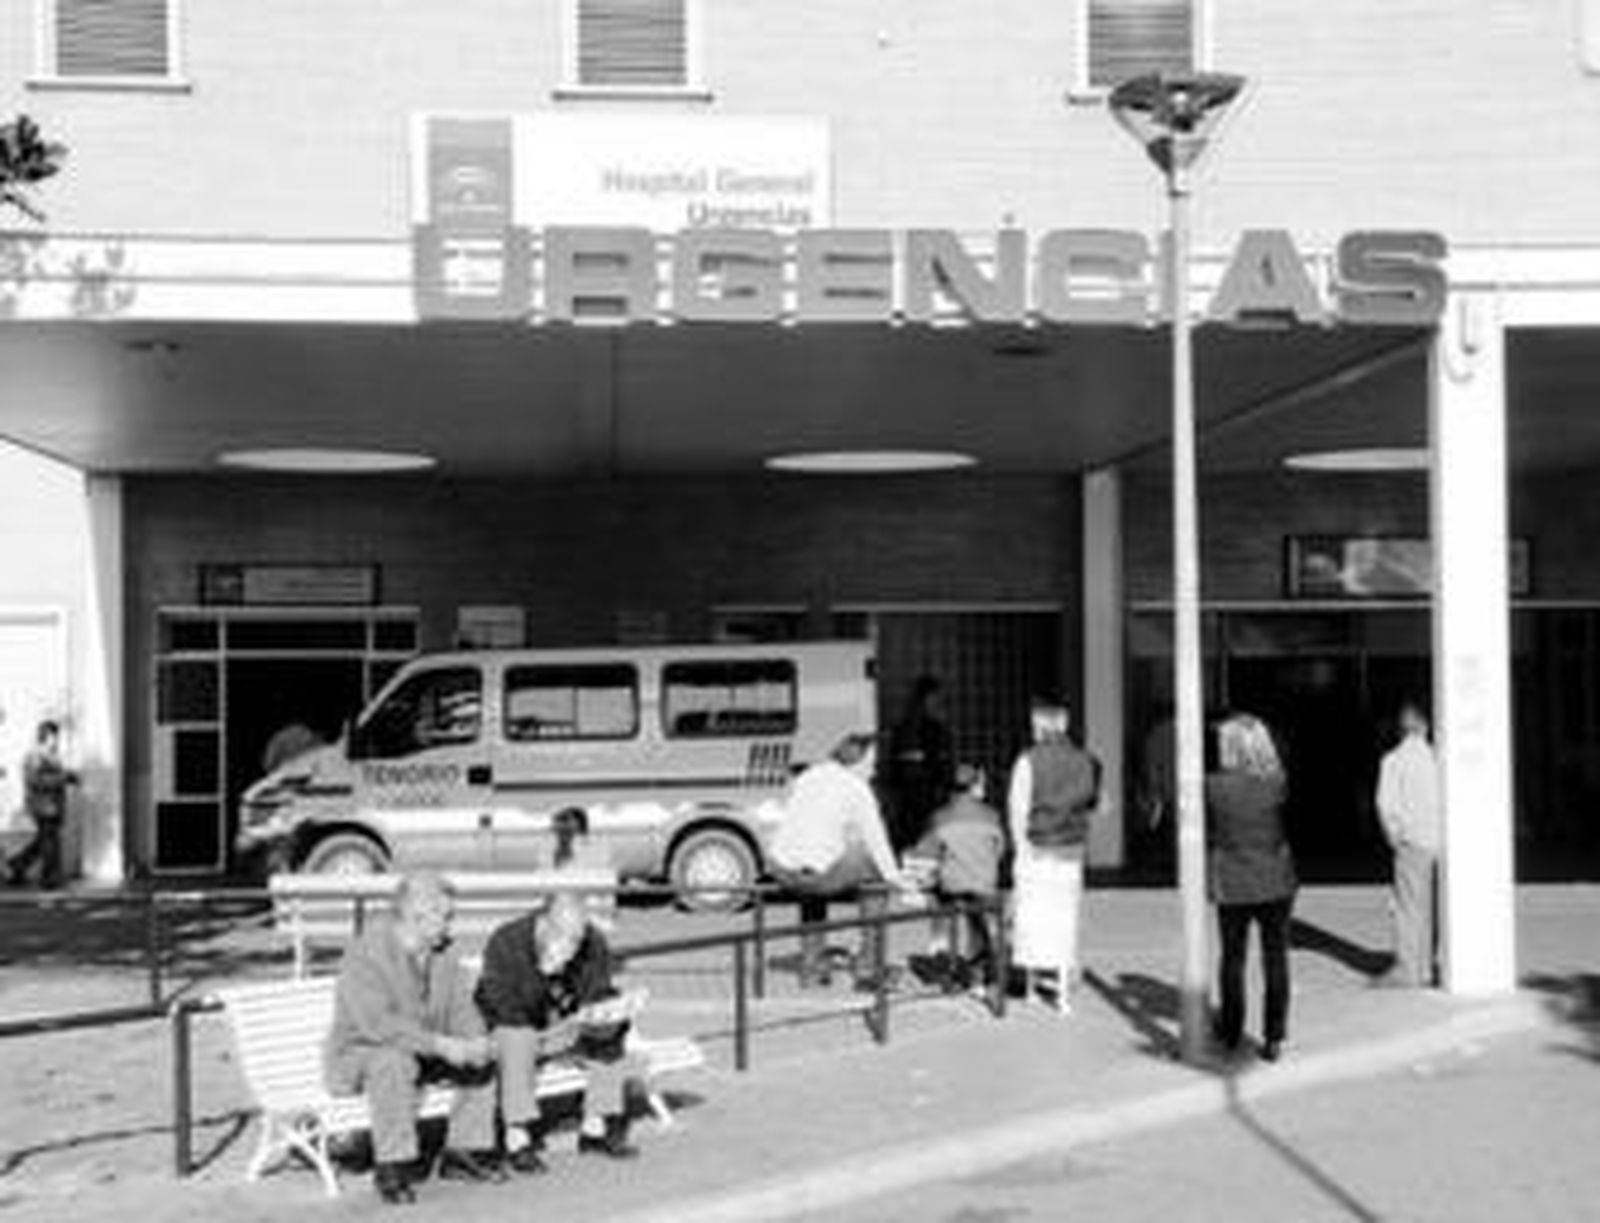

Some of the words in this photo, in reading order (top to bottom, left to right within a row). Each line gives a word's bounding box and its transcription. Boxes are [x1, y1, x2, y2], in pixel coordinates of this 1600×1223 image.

[604, 168, 708, 200] Hospital
[715, 168, 814, 194] General
[413, 225, 1449, 325] URGENCIAS
